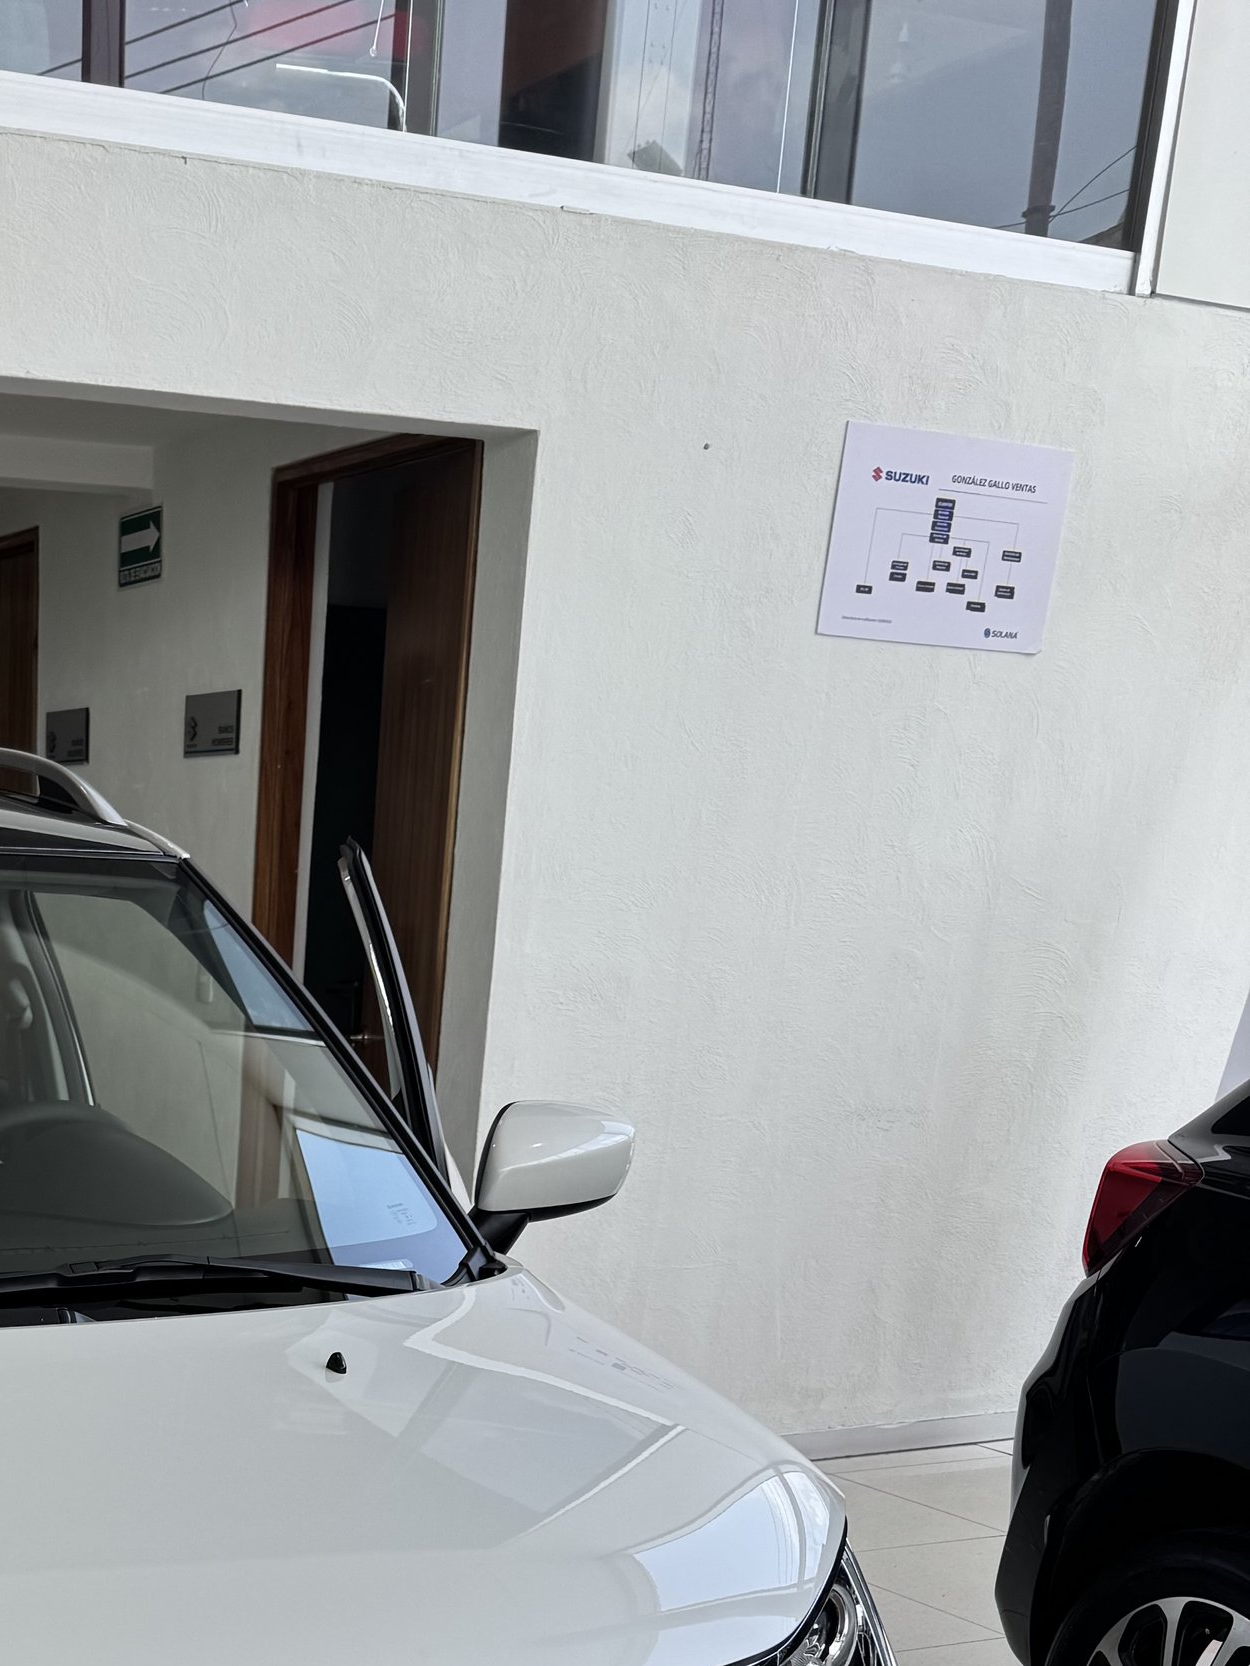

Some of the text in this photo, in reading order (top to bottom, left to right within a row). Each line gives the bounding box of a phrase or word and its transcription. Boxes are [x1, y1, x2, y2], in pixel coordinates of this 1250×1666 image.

[885, 469, 930, 486] SUZUKI
[951, 474, 1037, 494] GONZÁLEZ GALLO VENTAS
